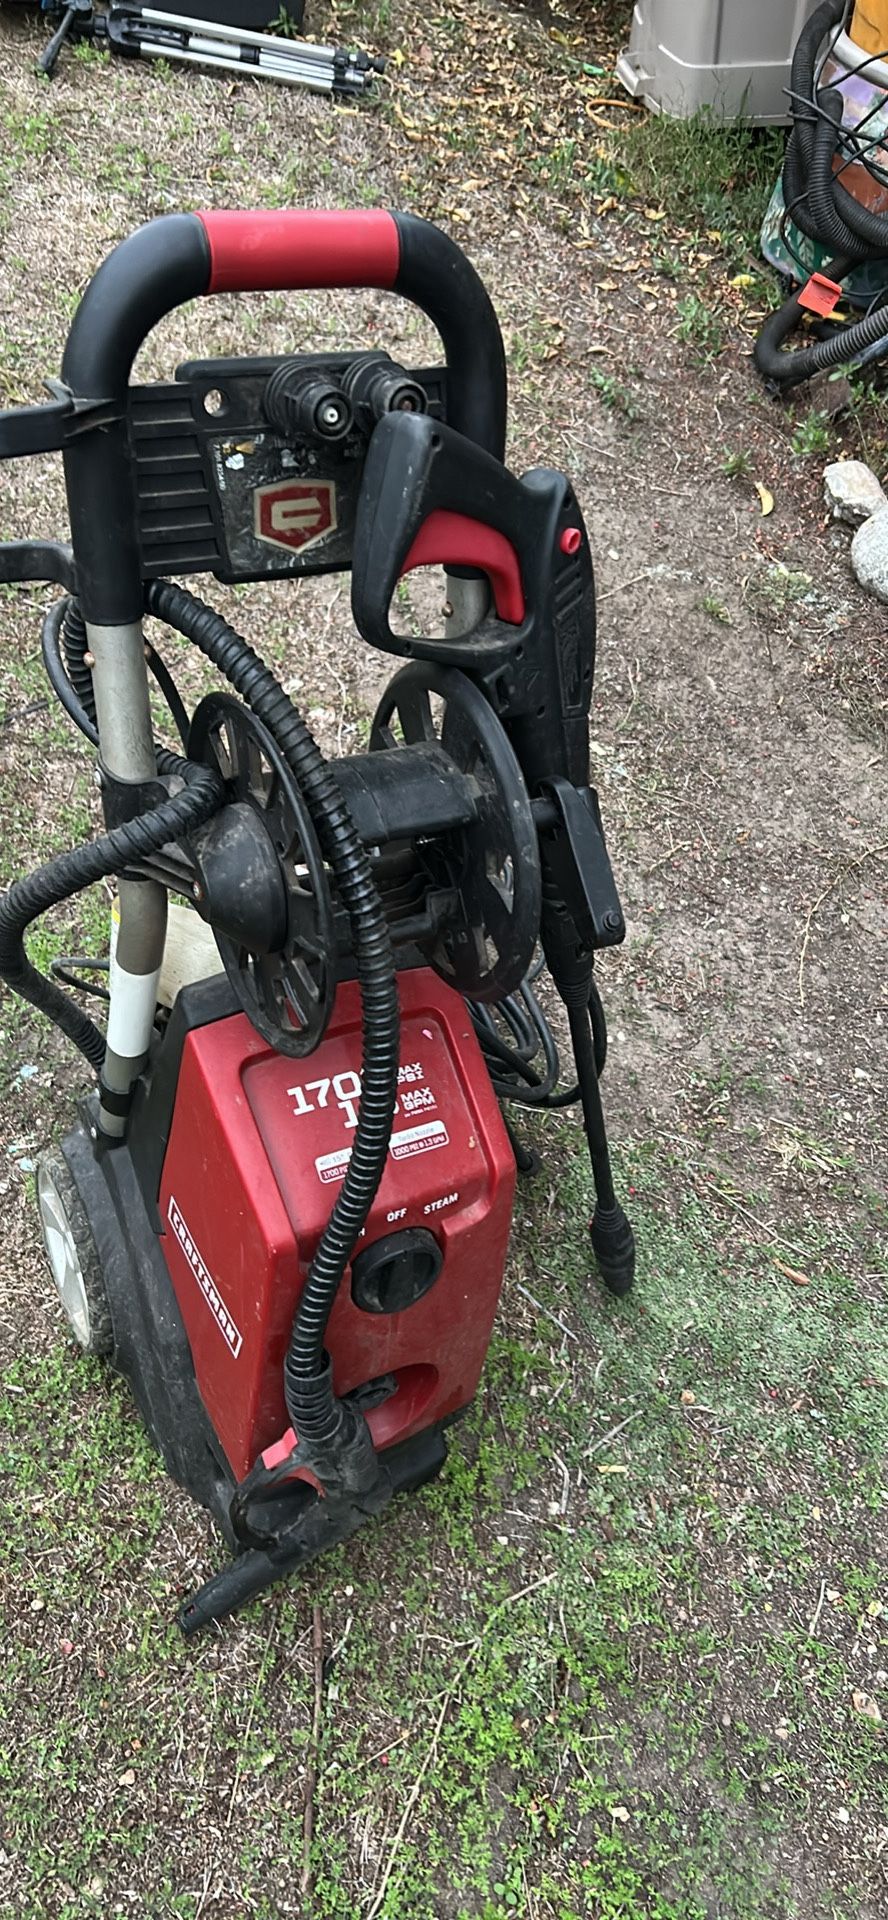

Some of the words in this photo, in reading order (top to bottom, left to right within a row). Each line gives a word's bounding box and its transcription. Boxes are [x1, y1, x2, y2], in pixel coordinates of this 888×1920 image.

[397, 1070, 425, 1085] PSI
[287, 1069, 365, 1116] 170
[400, 1087, 433, 1103] MAX
[403, 1095, 436, 1111] GPM
[322, 1167, 340, 1180] 1700
[424, 1192, 458, 1215] STEAM
[387, 1208, 407, 1222] OFF
[172, 1211, 237, 1344] CRAFTSMAN
